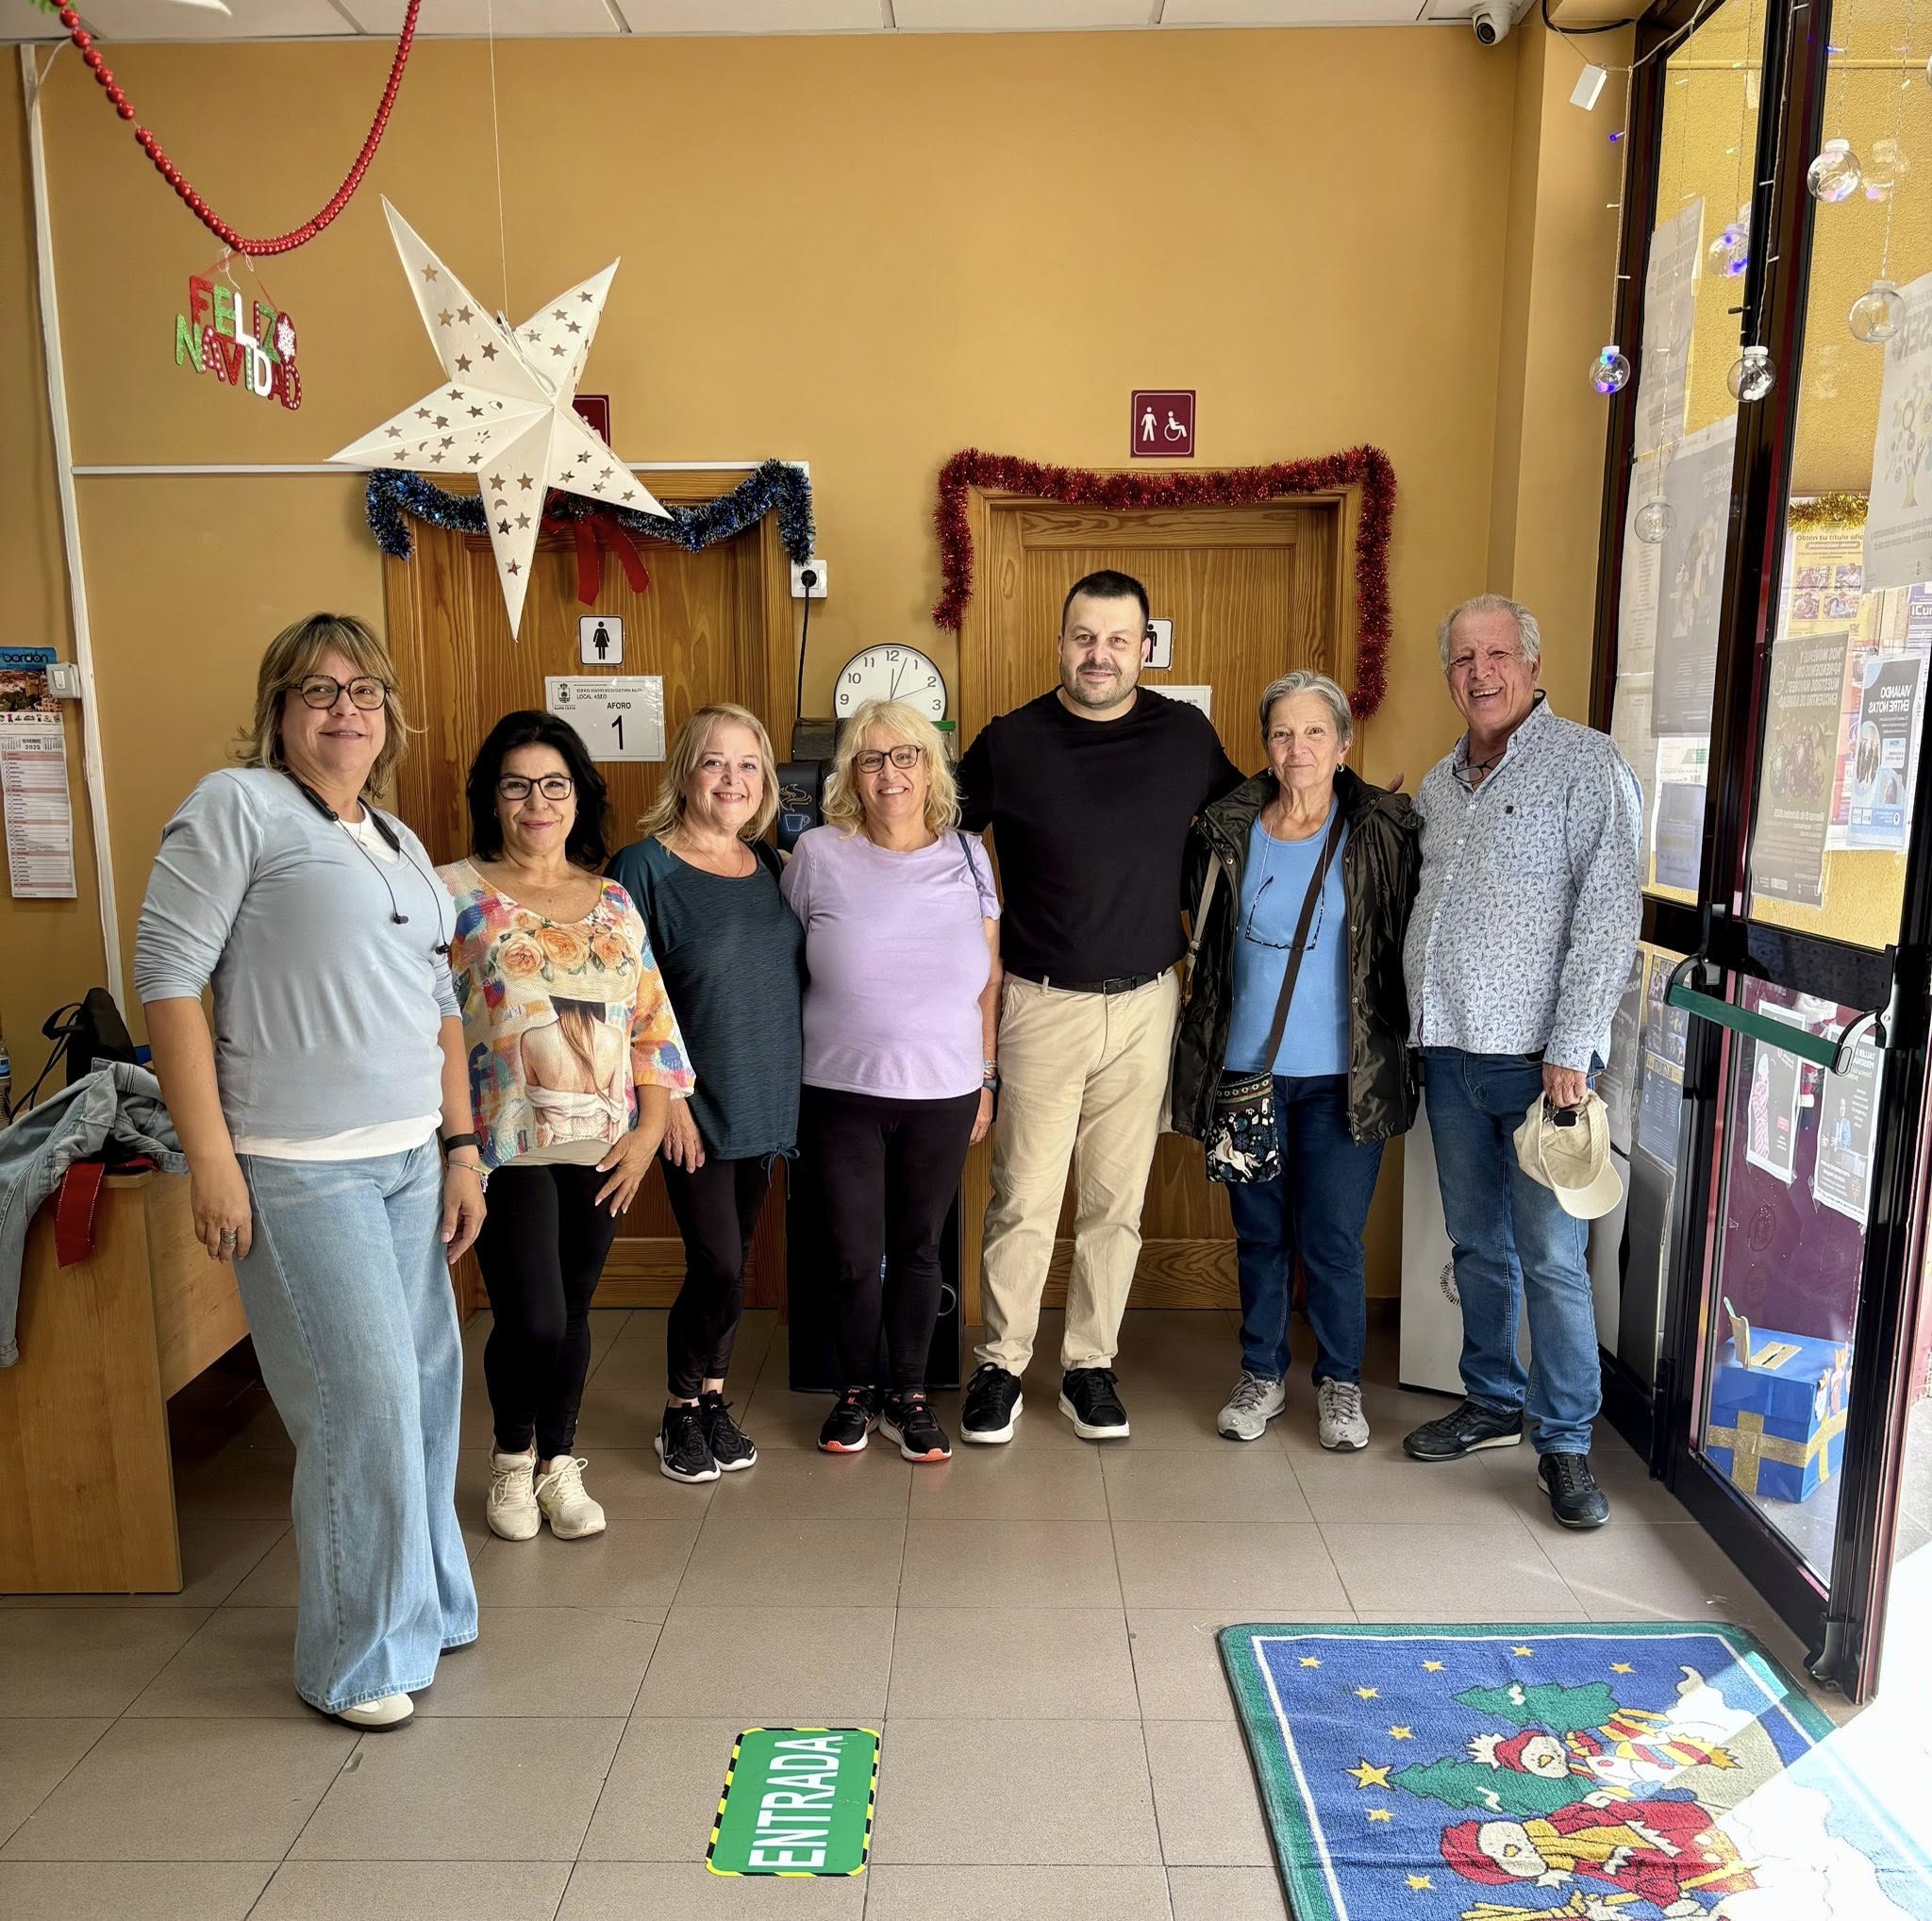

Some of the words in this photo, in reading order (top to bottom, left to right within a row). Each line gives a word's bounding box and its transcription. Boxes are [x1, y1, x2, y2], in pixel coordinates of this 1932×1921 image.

[190, 276, 281, 362] FELIZ
[175, 313, 302, 410] NAVIDAD
[886, 650, 900, 661] 12
[864, 657, 874, 668] 11
[914, 659, 919, 670] 1
[848, 673, 861, 684] 10
[927, 676, 937, 688] 2
[840, 693, 849, 705] 9
[932, 699, 941, 710] 3
[611, 714, 624, 750] 1
[748, 1735, 843, 1866] ENTRADA
